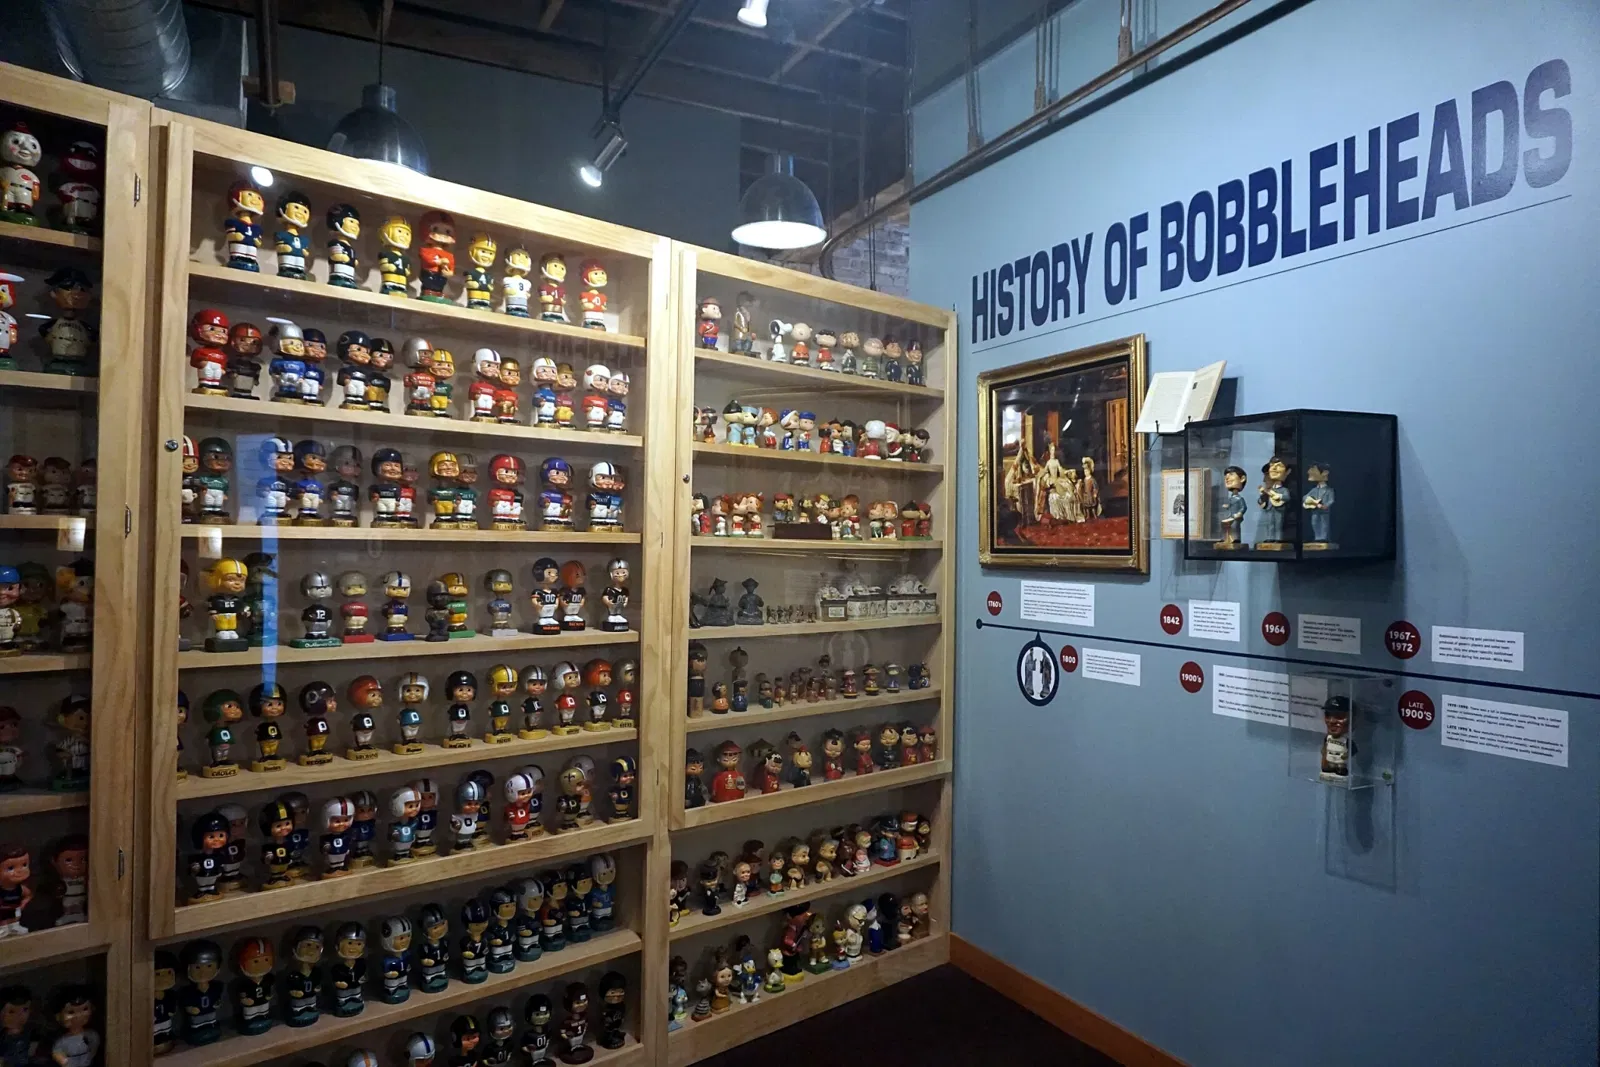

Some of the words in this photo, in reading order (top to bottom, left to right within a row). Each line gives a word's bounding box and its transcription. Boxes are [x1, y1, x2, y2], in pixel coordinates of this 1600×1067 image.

[972, 232, 1094, 344] HISTORY
[1104, 212, 1149, 306] OF
[1160, 58, 1572, 292] BOBBLEHEADS
[316, 610, 326, 619] 12
[1163, 615, 1180, 625] 1842
[1265, 624, 1286, 635] 1964
[1389, 630, 1416, 641] 1967-
[1391, 641, 1413, 652] 1972
[1062, 655, 1076, 664] 1800
[1408, 701, 1425, 709] LATE
[1400, 707, 1432, 721] 1900'S
[474, 942, 482, 953] 7
[256, 987, 263, 998] 2
